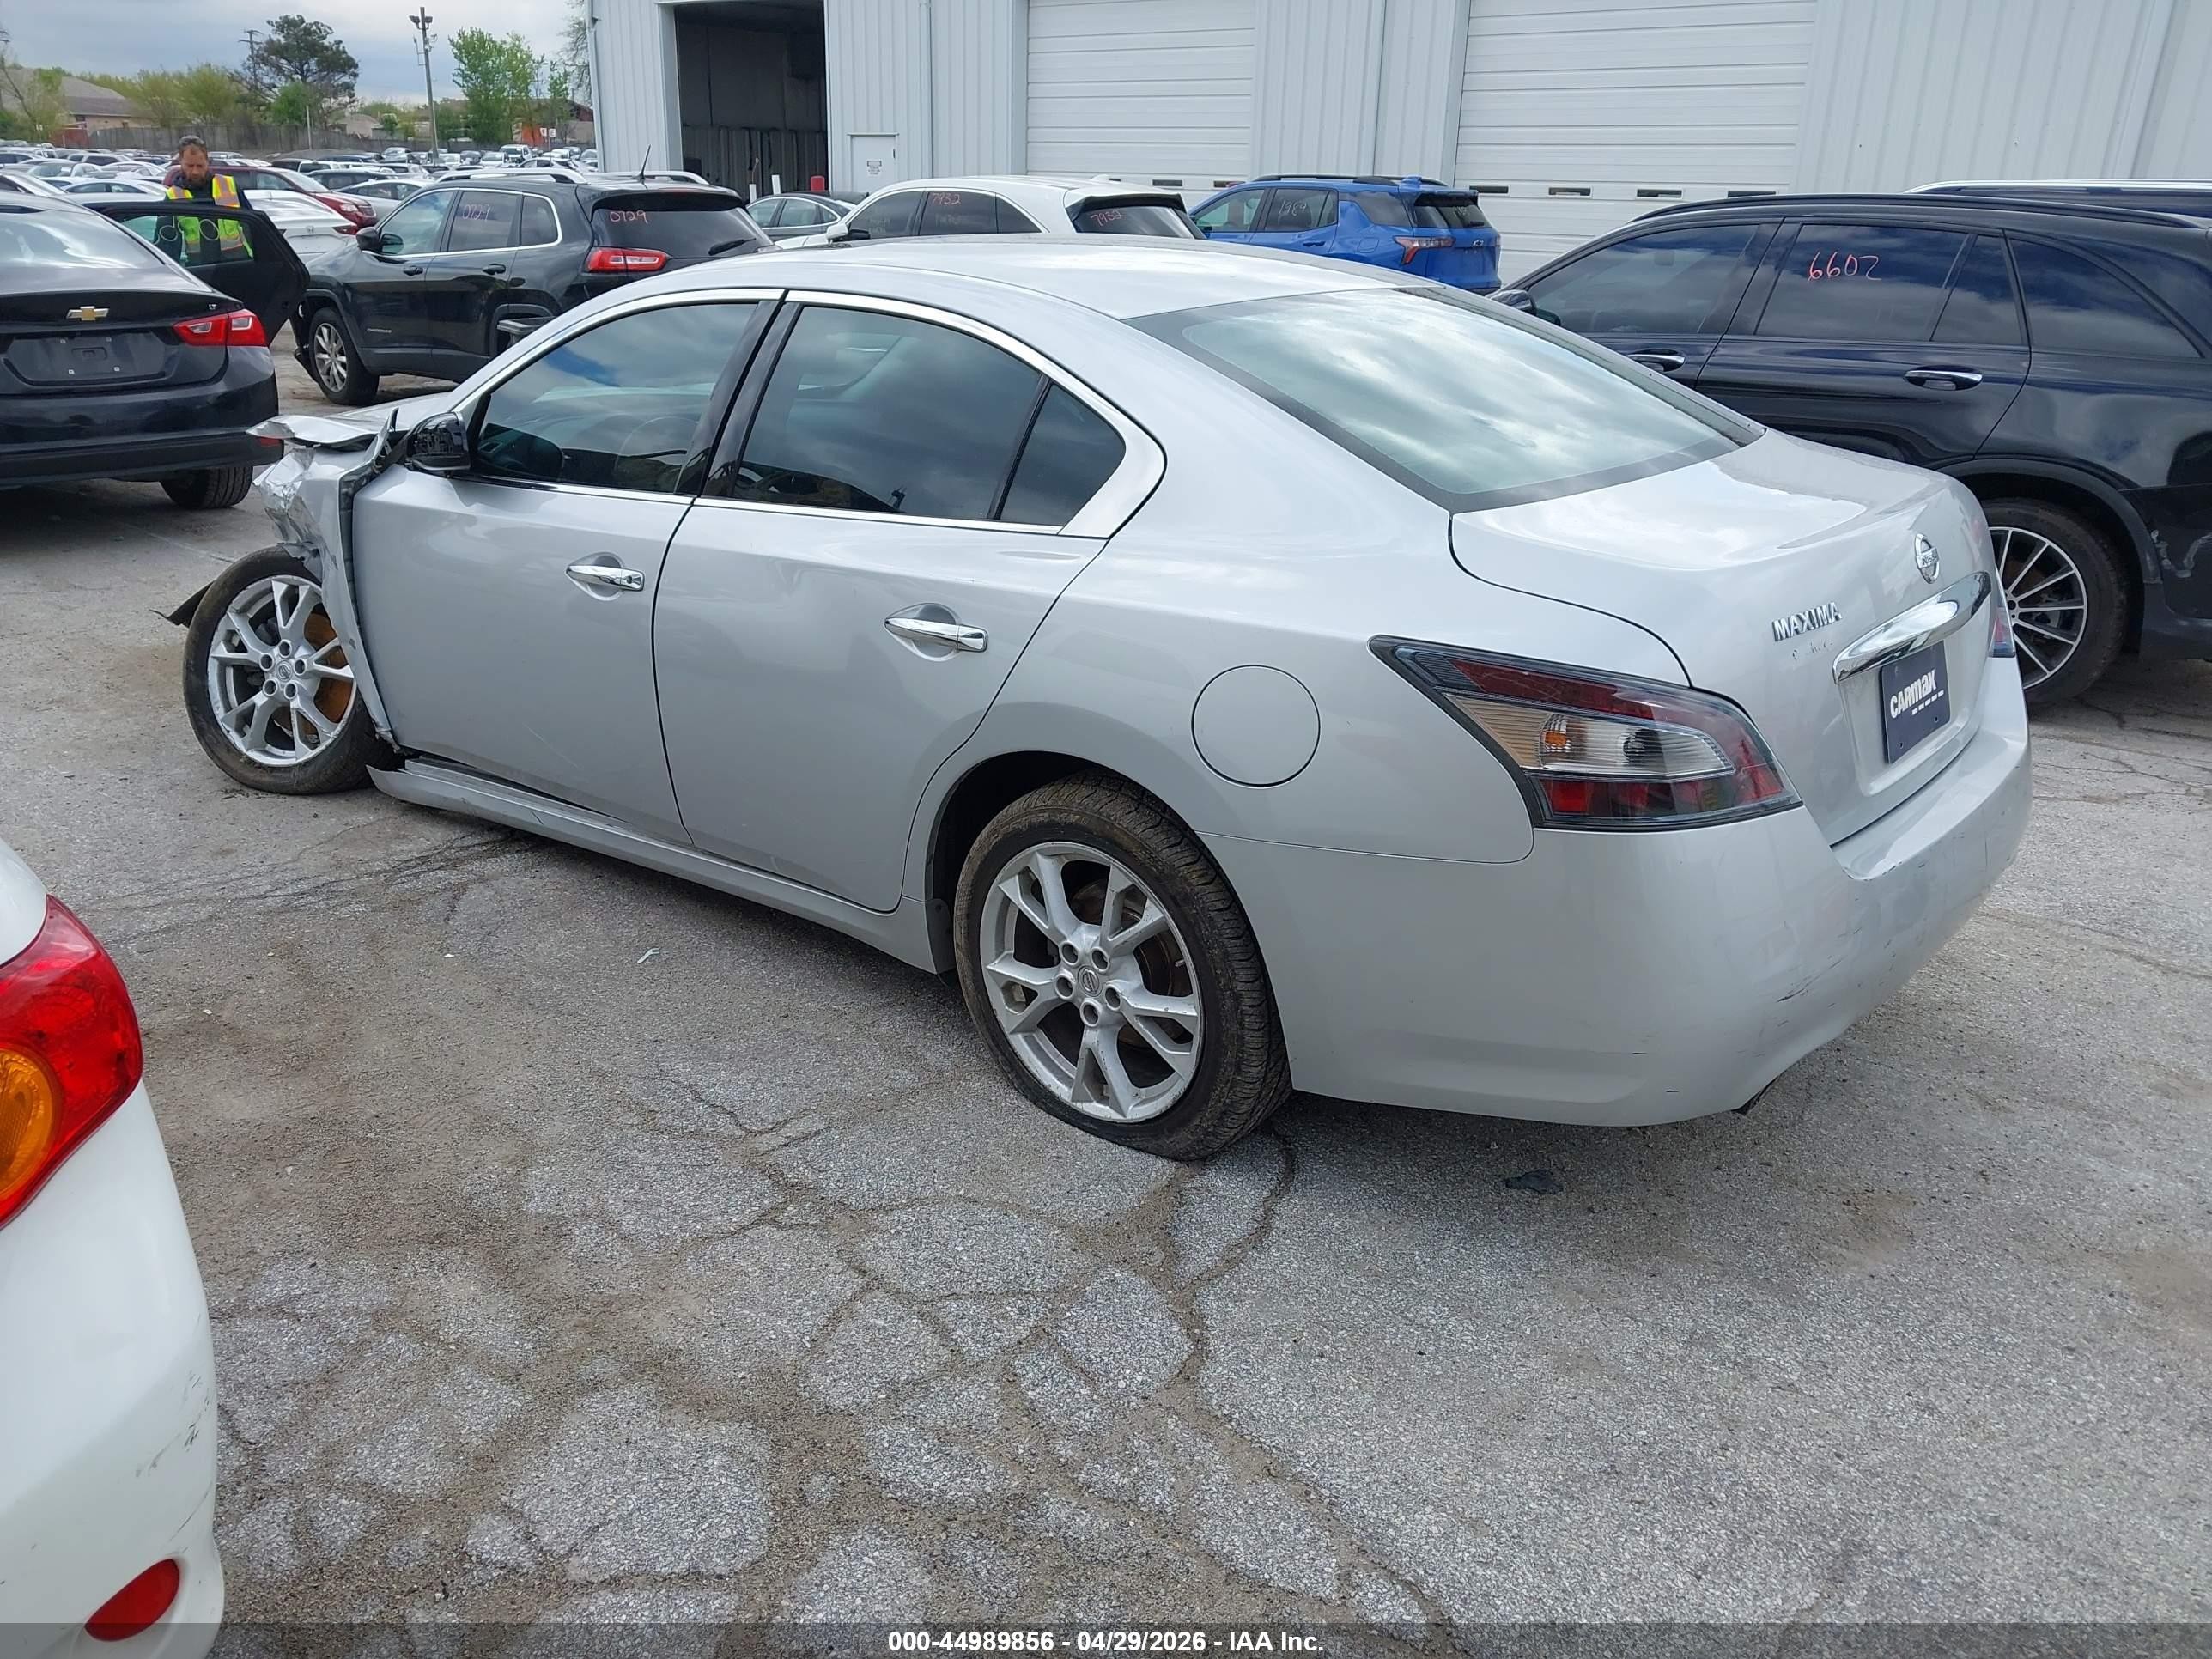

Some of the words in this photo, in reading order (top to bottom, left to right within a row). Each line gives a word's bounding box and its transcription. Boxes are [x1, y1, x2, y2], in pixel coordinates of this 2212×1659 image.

[932, 191, 962, 206] 7932
[609, 210, 648, 224] 0729
[1807, 250, 1882, 282] 6602
[1771, 602, 1843, 642] MAXIMA
